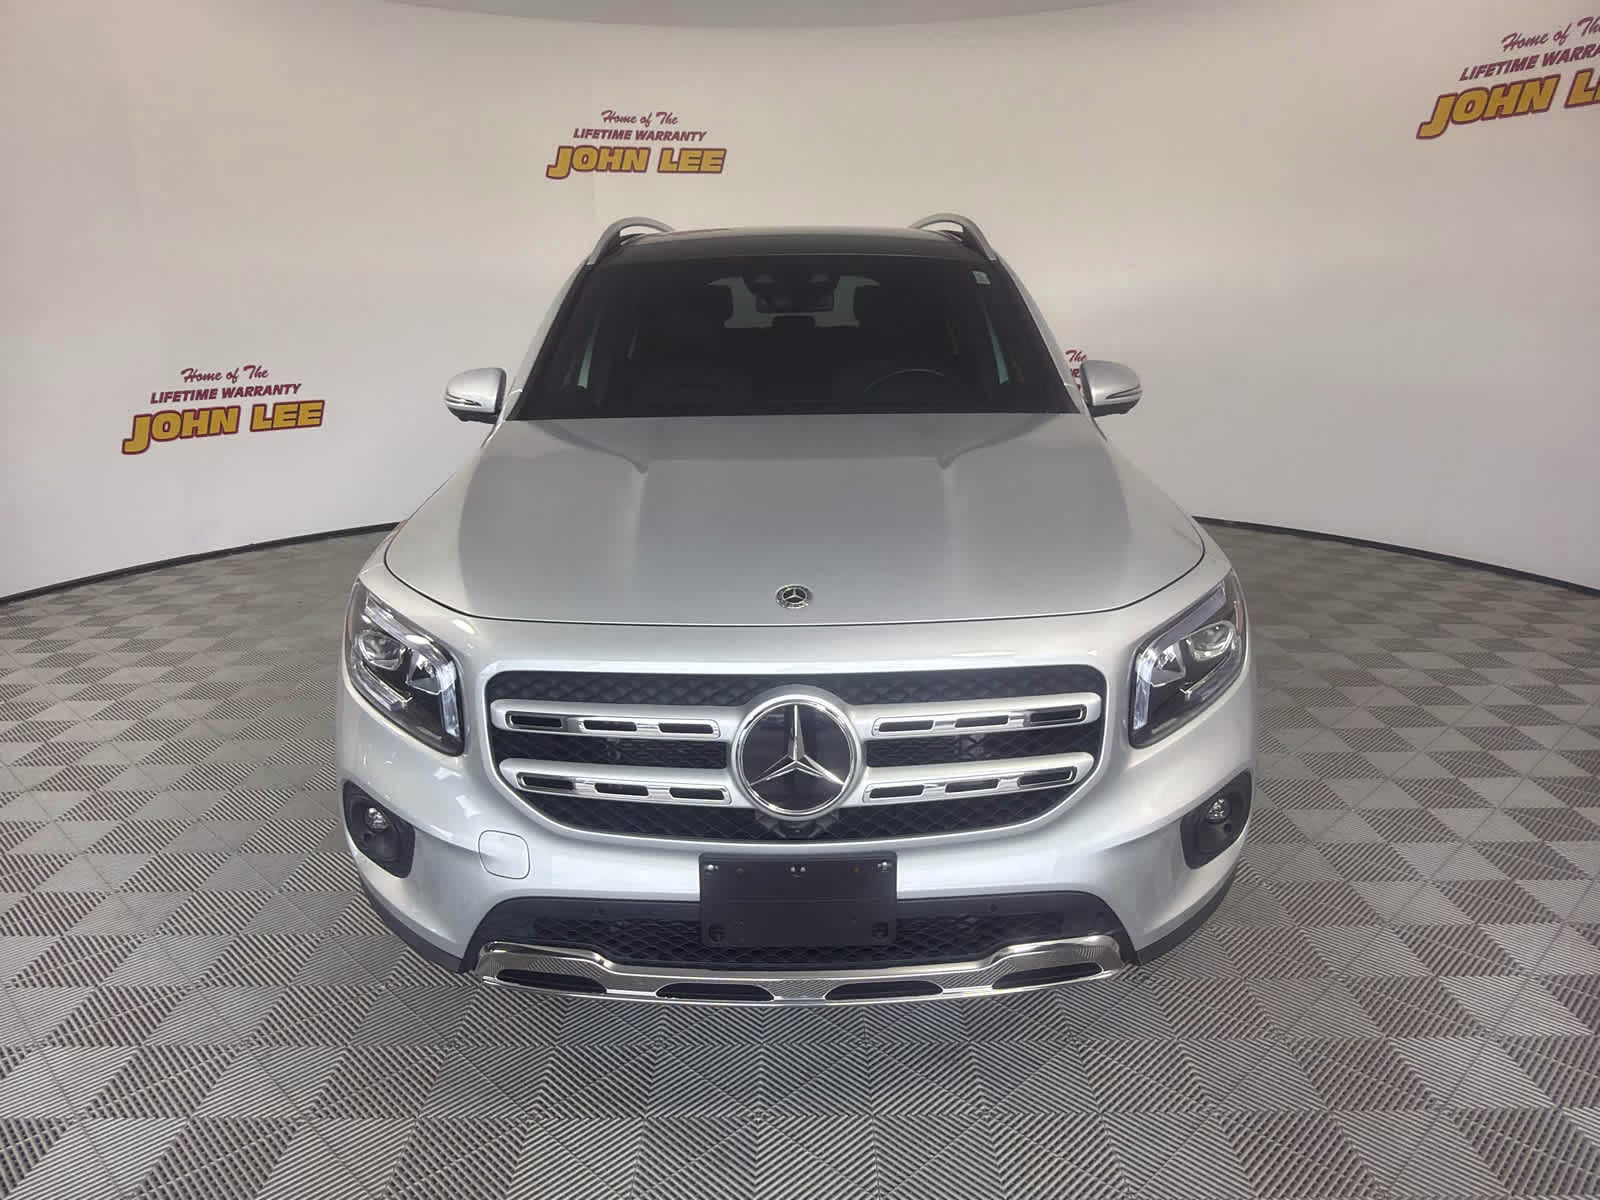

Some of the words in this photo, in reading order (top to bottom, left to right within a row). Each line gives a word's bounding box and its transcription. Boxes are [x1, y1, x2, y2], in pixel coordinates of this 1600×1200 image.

[1501, 32, 1549, 52] Home
[1553, 23, 1572, 46] of
[1458, 54, 1540, 81] LIFETIME
[601, 110, 637, 124] Home
[640, 112, 652, 127] of
[655, 111, 679, 125] The
[1416, 74, 1561, 139] JOHN
[573, 128, 633, 141] LIFETIME
[635, 130, 707, 142] WARRANTY
[546, 145, 651, 180] JOHN
[657, 147, 727, 173] LEE
[180, 368, 222, 383] Home
[226, 368, 239, 384] of
[243, 365, 269, 380] The
[150, 388, 218, 404] LIFETIME
[221, 383, 301, 400] WARRANTY
[121, 405, 241, 455] JOHN
[249, 400, 325, 432] LEE
